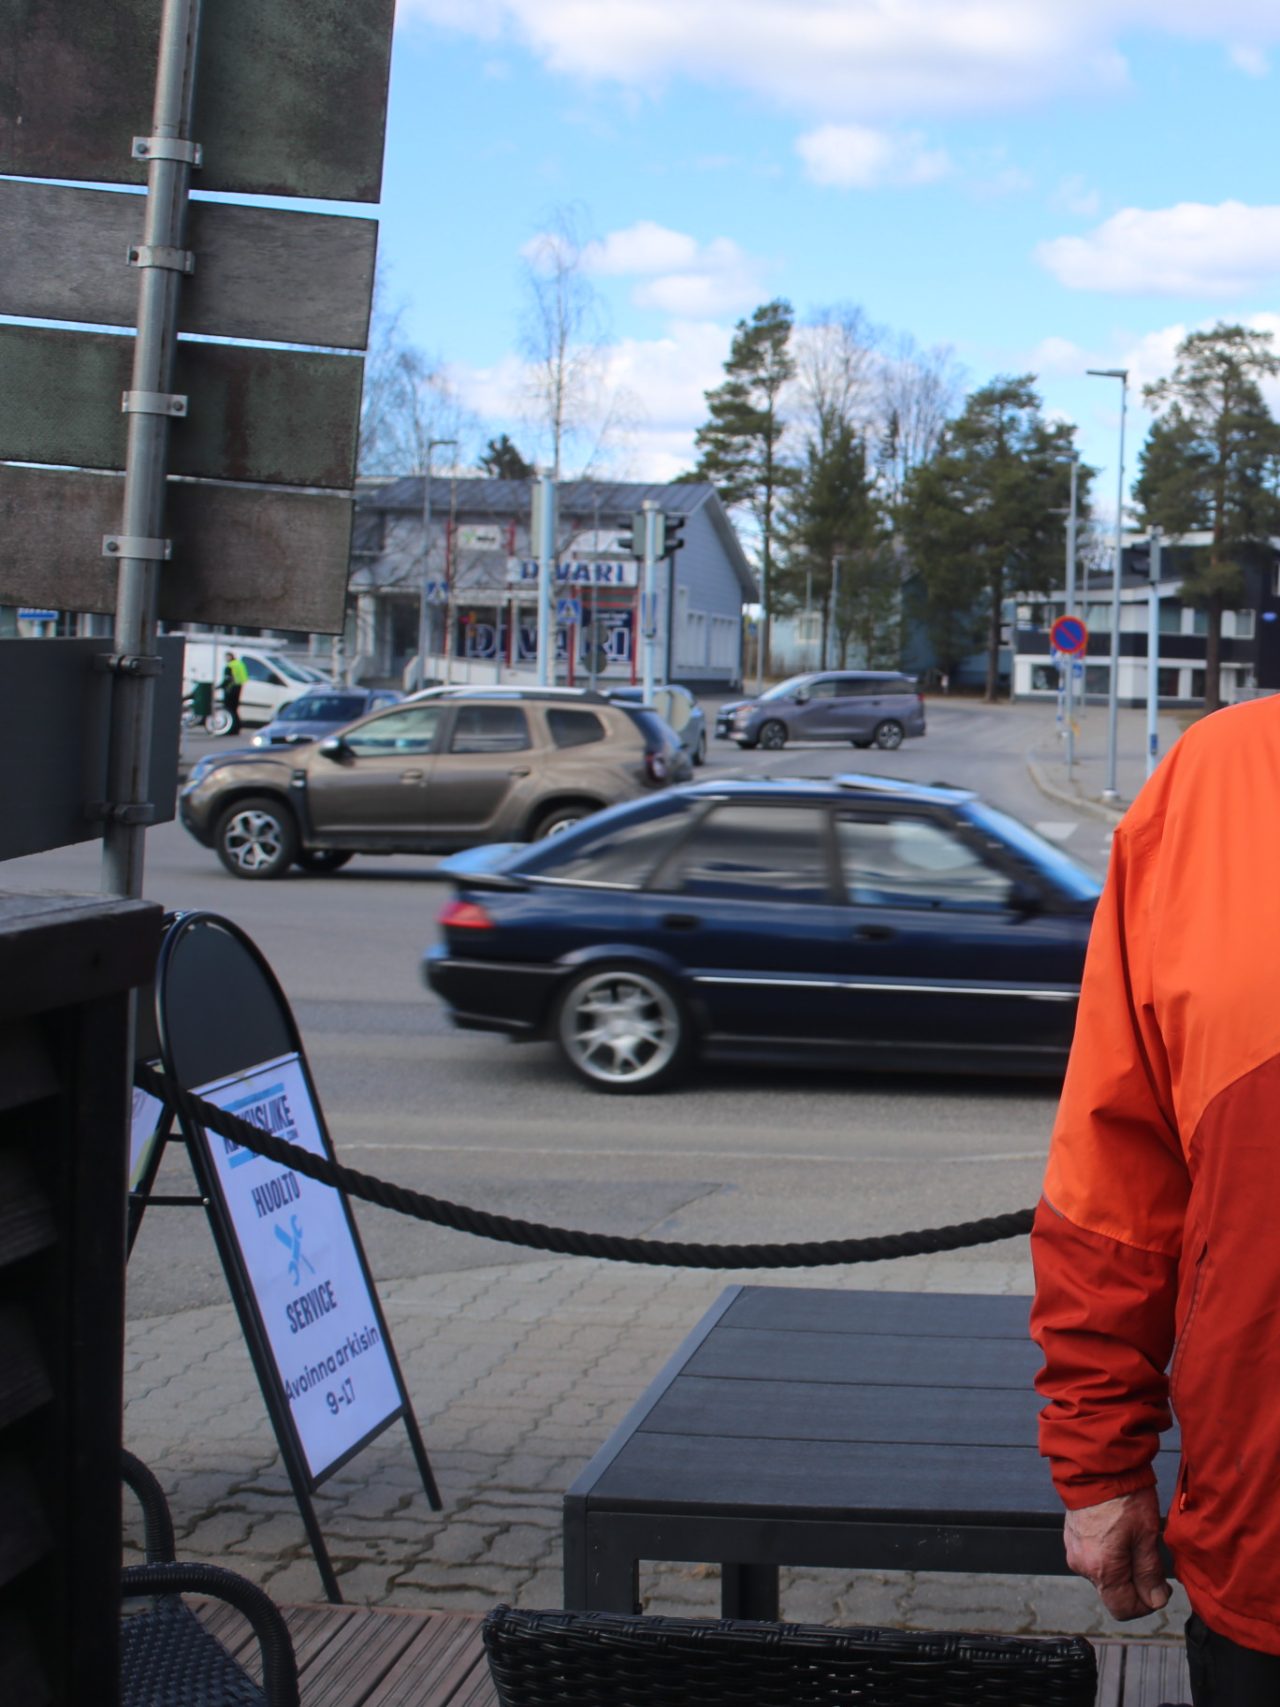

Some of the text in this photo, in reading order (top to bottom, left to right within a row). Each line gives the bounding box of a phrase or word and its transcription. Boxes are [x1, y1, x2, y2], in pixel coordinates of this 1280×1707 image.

[521, 560, 623, 582] DVARI
[251, 1170, 300, 1218] HUOLTO
[286, 1279, 337, 1334] SERVICE
[284, 1325, 379, 1401] Avoinna arkisin
[326, 1377, 356, 1415] 9-17
